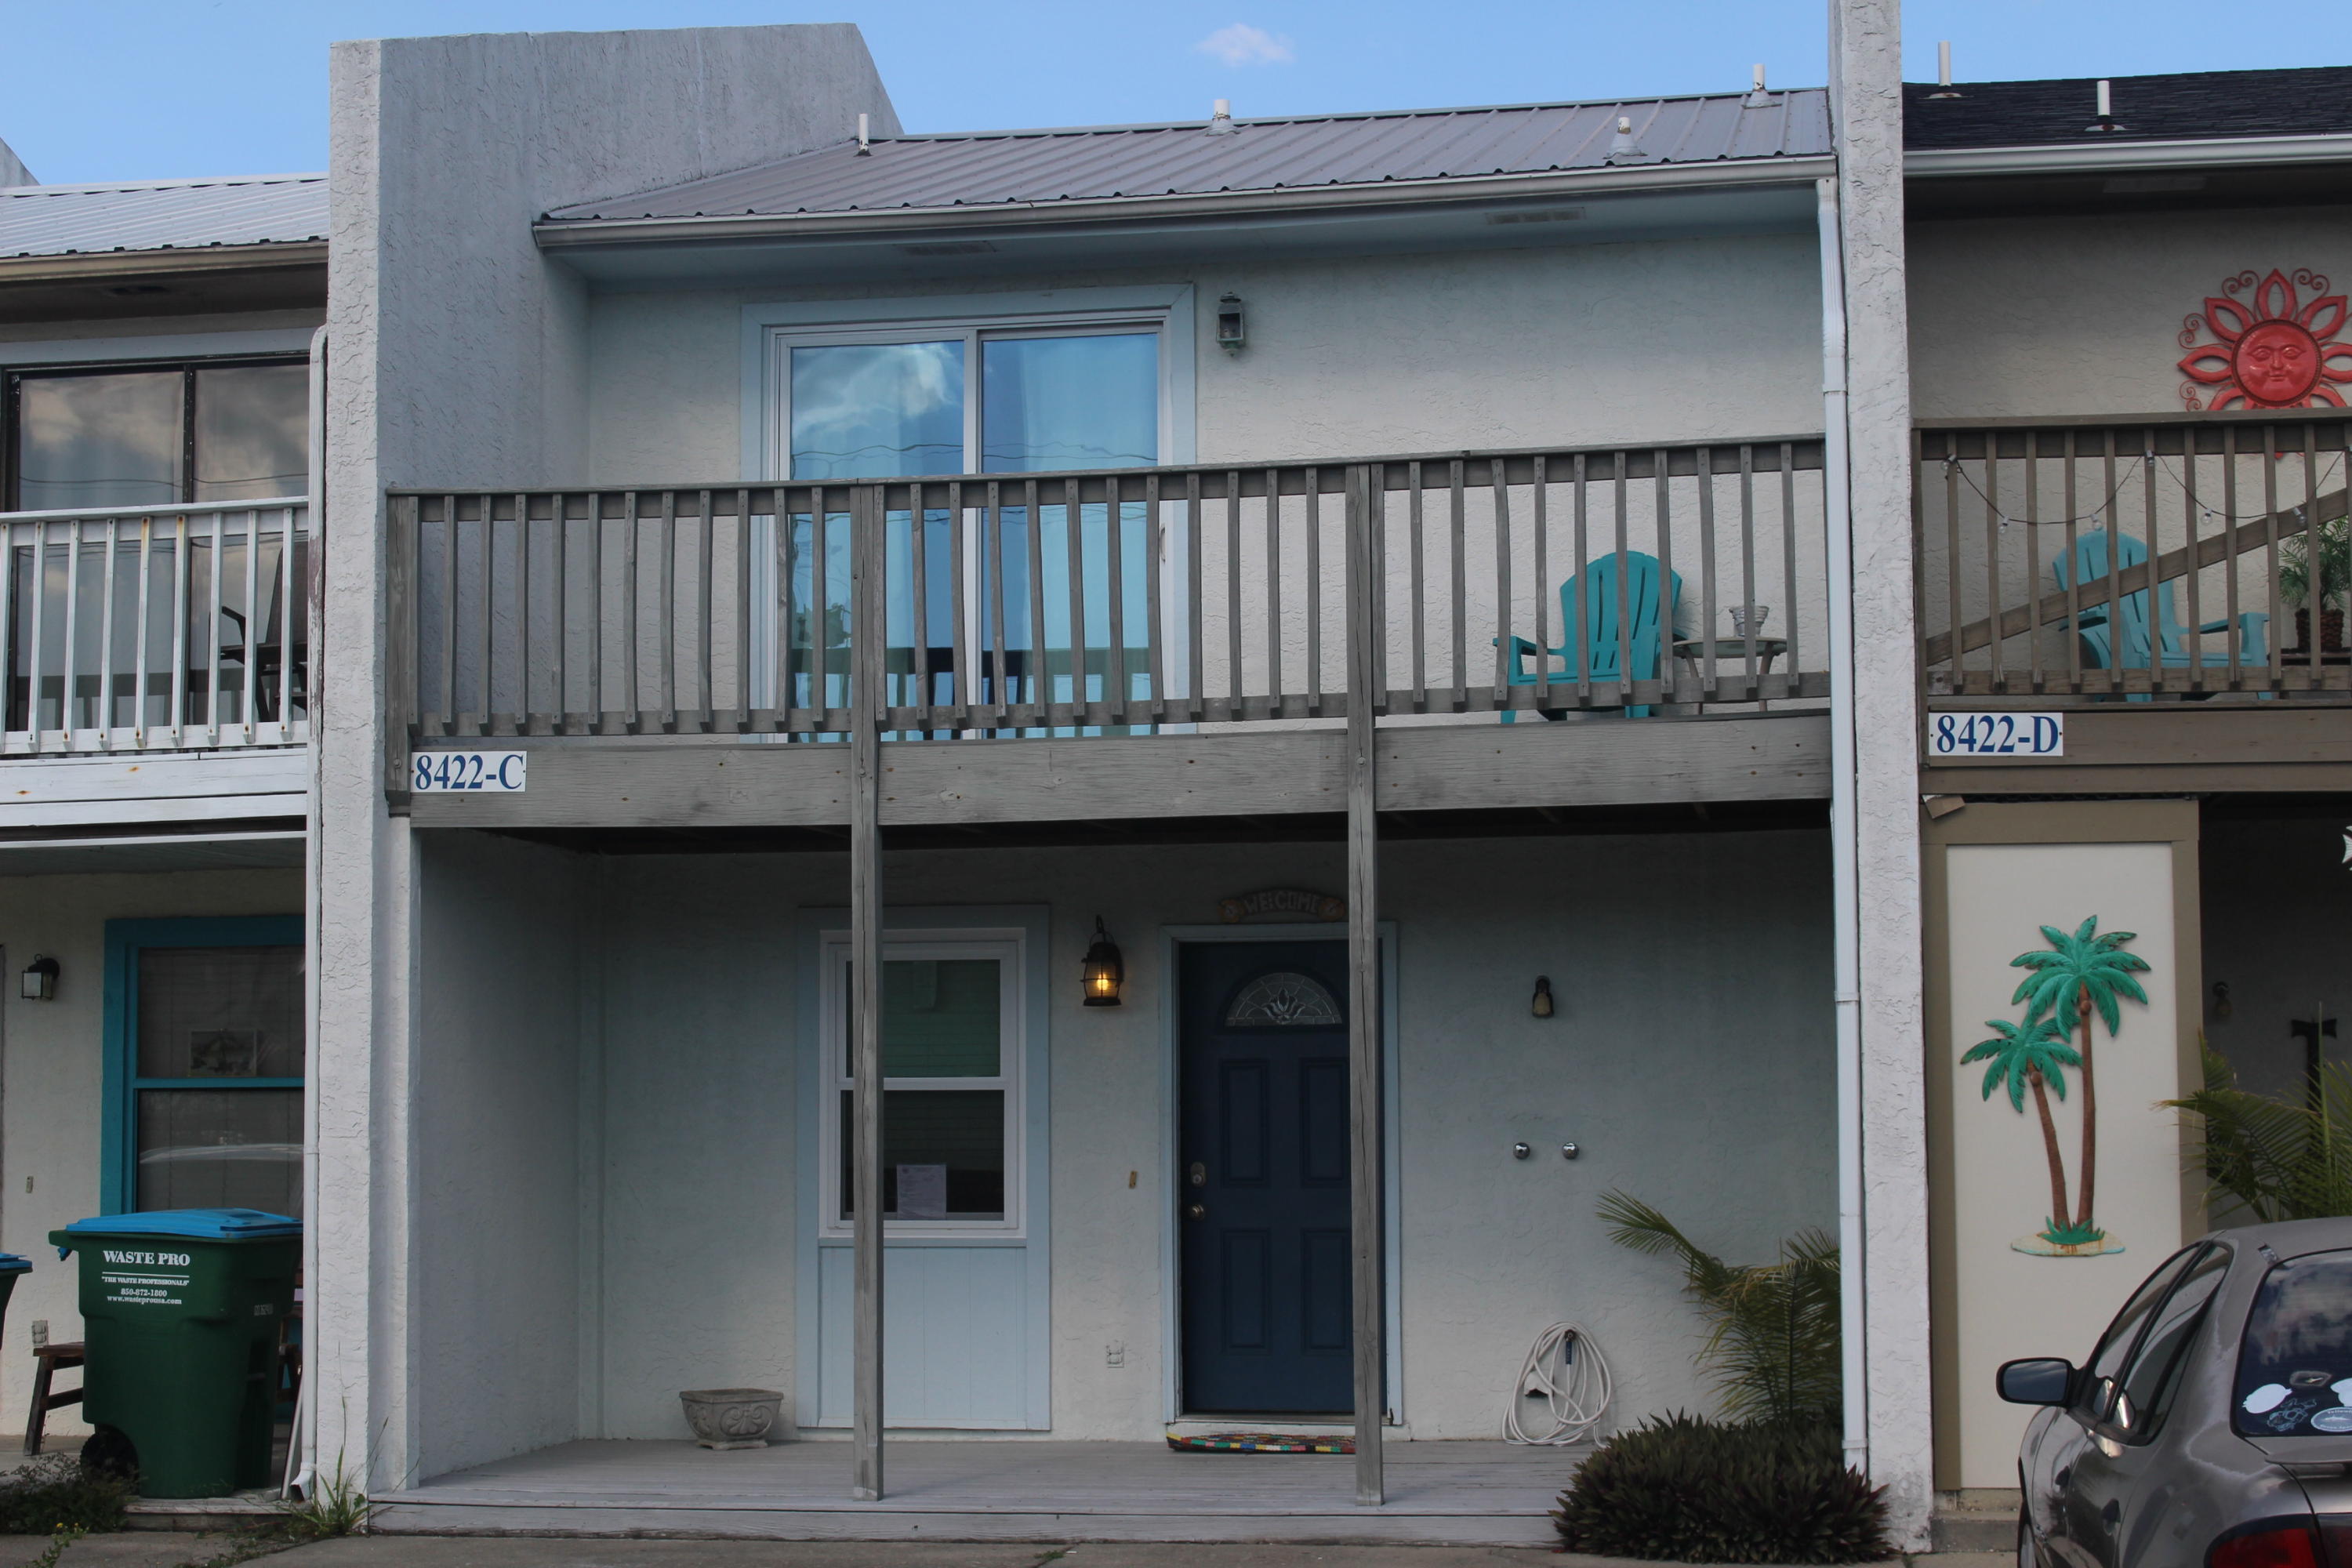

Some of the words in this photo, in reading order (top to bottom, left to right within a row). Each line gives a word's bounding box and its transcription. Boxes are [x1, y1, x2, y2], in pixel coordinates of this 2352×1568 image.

[1936, 715, 2059, 753] 8422-D
[416, 754, 524, 790] 8422-C
[103, 1250, 154, 1265] WASTE
[158, 1253, 191, 1266] PRO
[107, 1296, 182, 1305] www.wasteprousa.com
[121, 1288, 168, 1297] 850-872-1800
